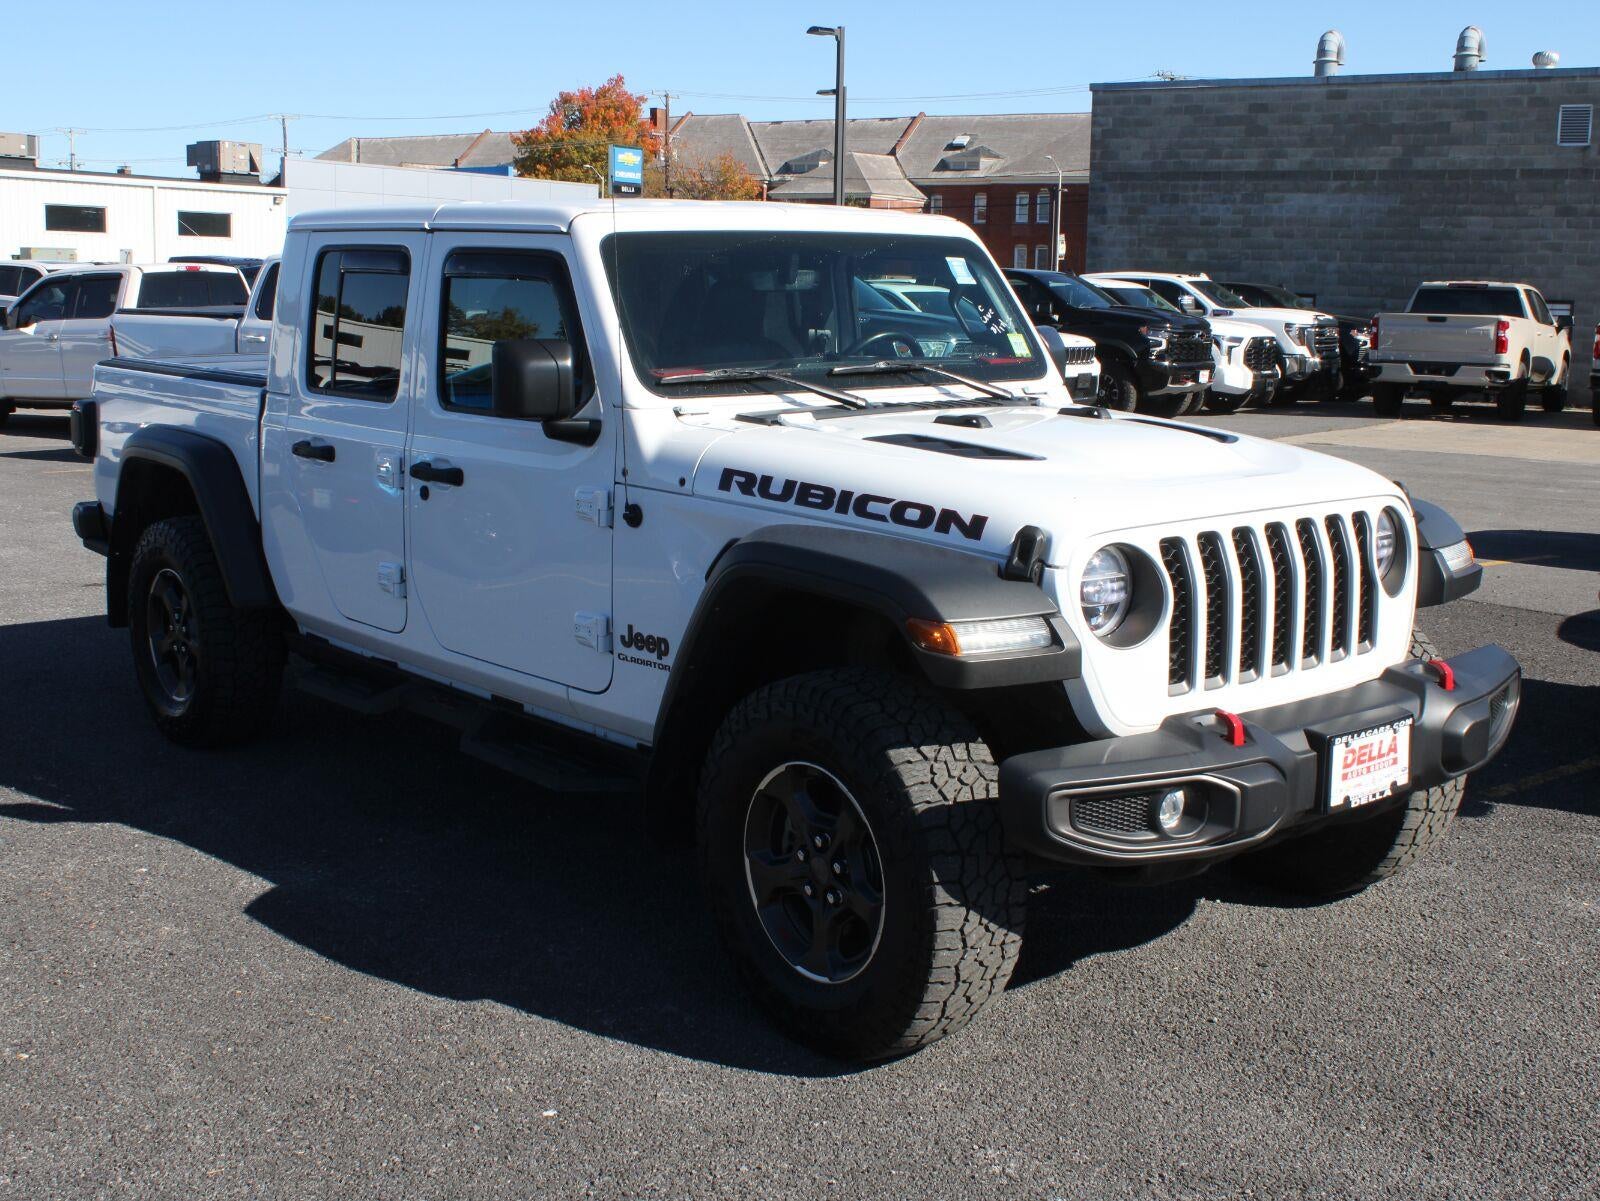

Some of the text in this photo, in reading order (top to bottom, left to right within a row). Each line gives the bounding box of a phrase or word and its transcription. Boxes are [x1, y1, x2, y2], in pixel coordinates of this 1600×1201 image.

[718, 467, 989, 541] RUBICON
[620, 623, 670, 661] Jeep
[617, 652, 672, 672] GLADIATOR
[1334, 717, 1413, 746] DELLACARS.COM
[1341, 735, 1398, 770] DELLA
[1351, 789, 1392, 808] DELLA
